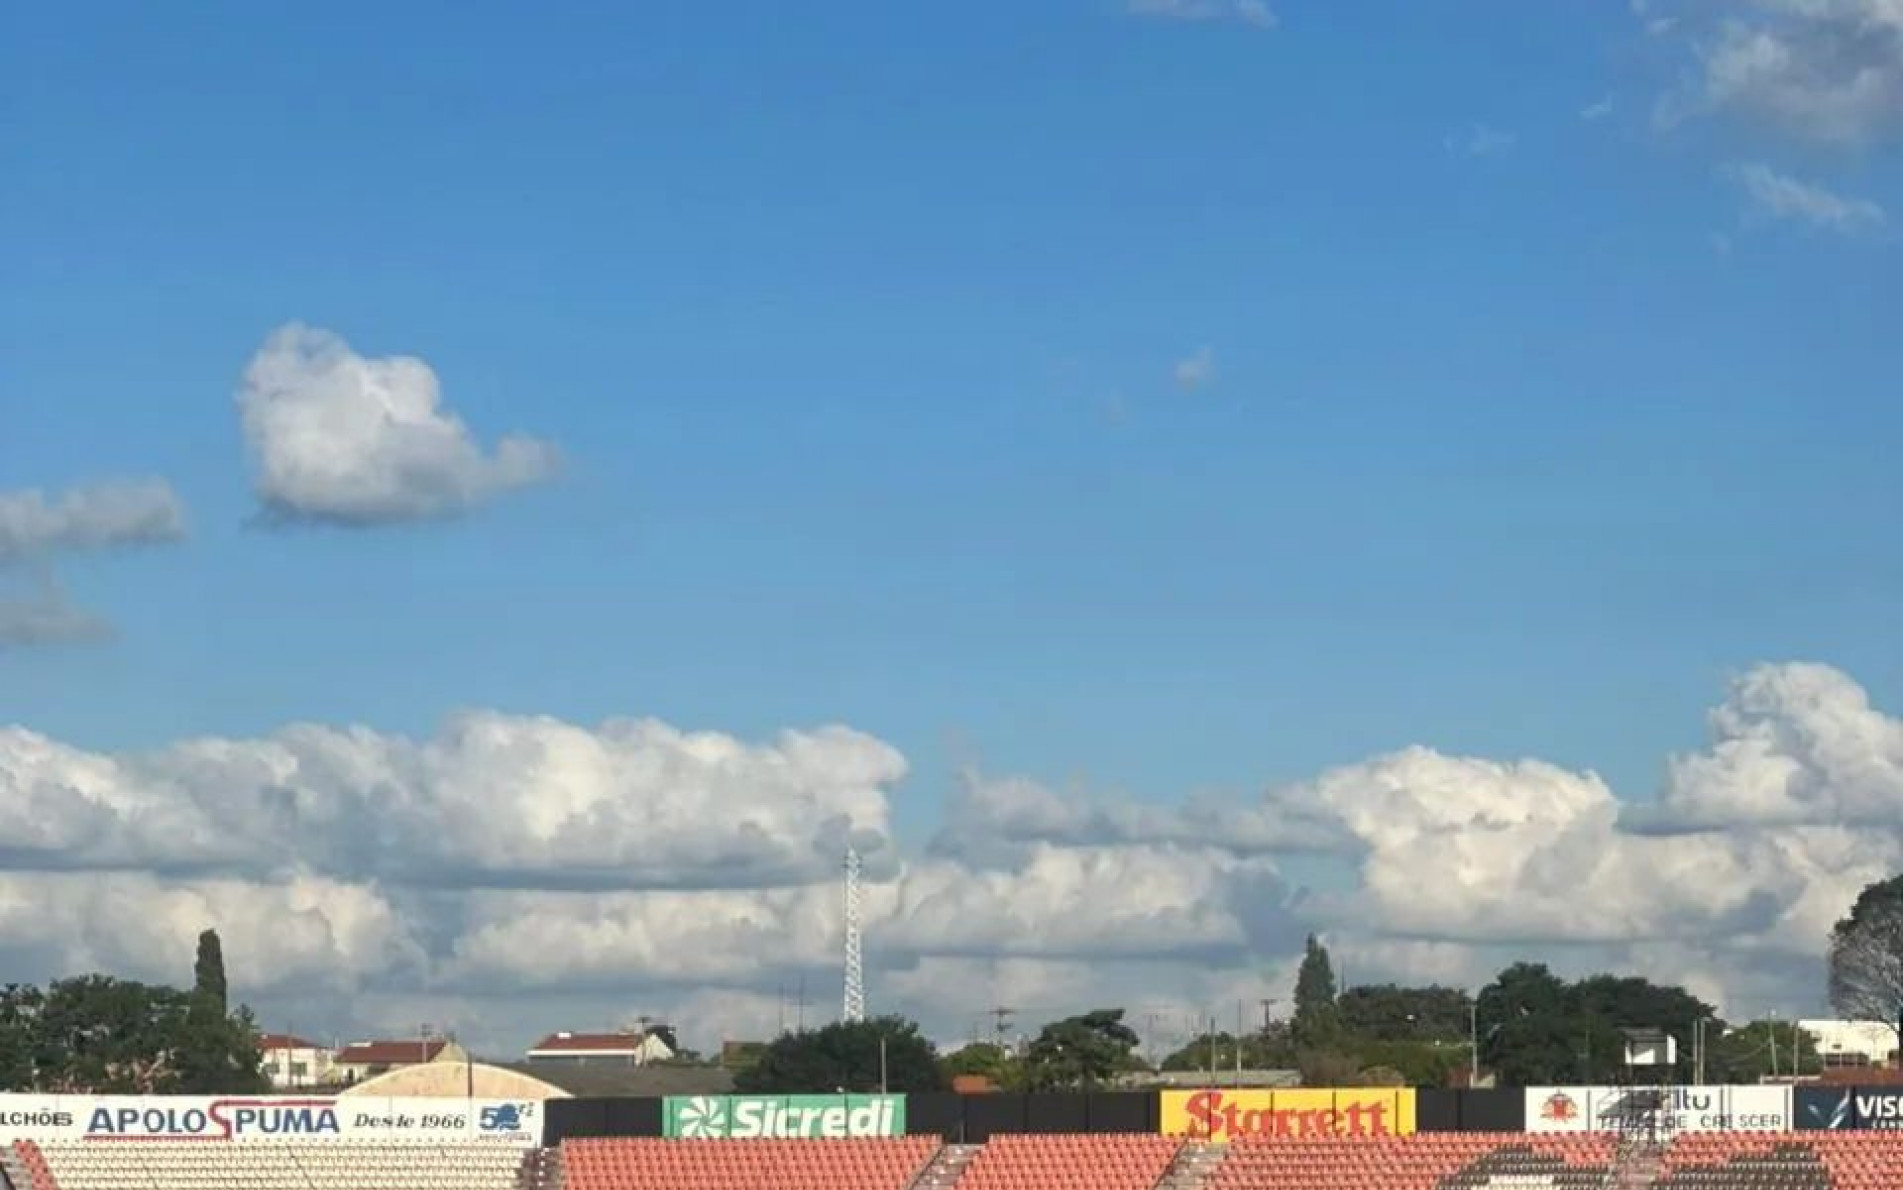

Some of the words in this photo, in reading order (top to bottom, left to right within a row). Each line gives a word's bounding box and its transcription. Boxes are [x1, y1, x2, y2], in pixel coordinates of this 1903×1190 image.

[420, 1113, 467, 1129] 1966
[730, 1099, 895, 1138] Sicredi
[1185, 1091, 1388, 1138] Starrett
